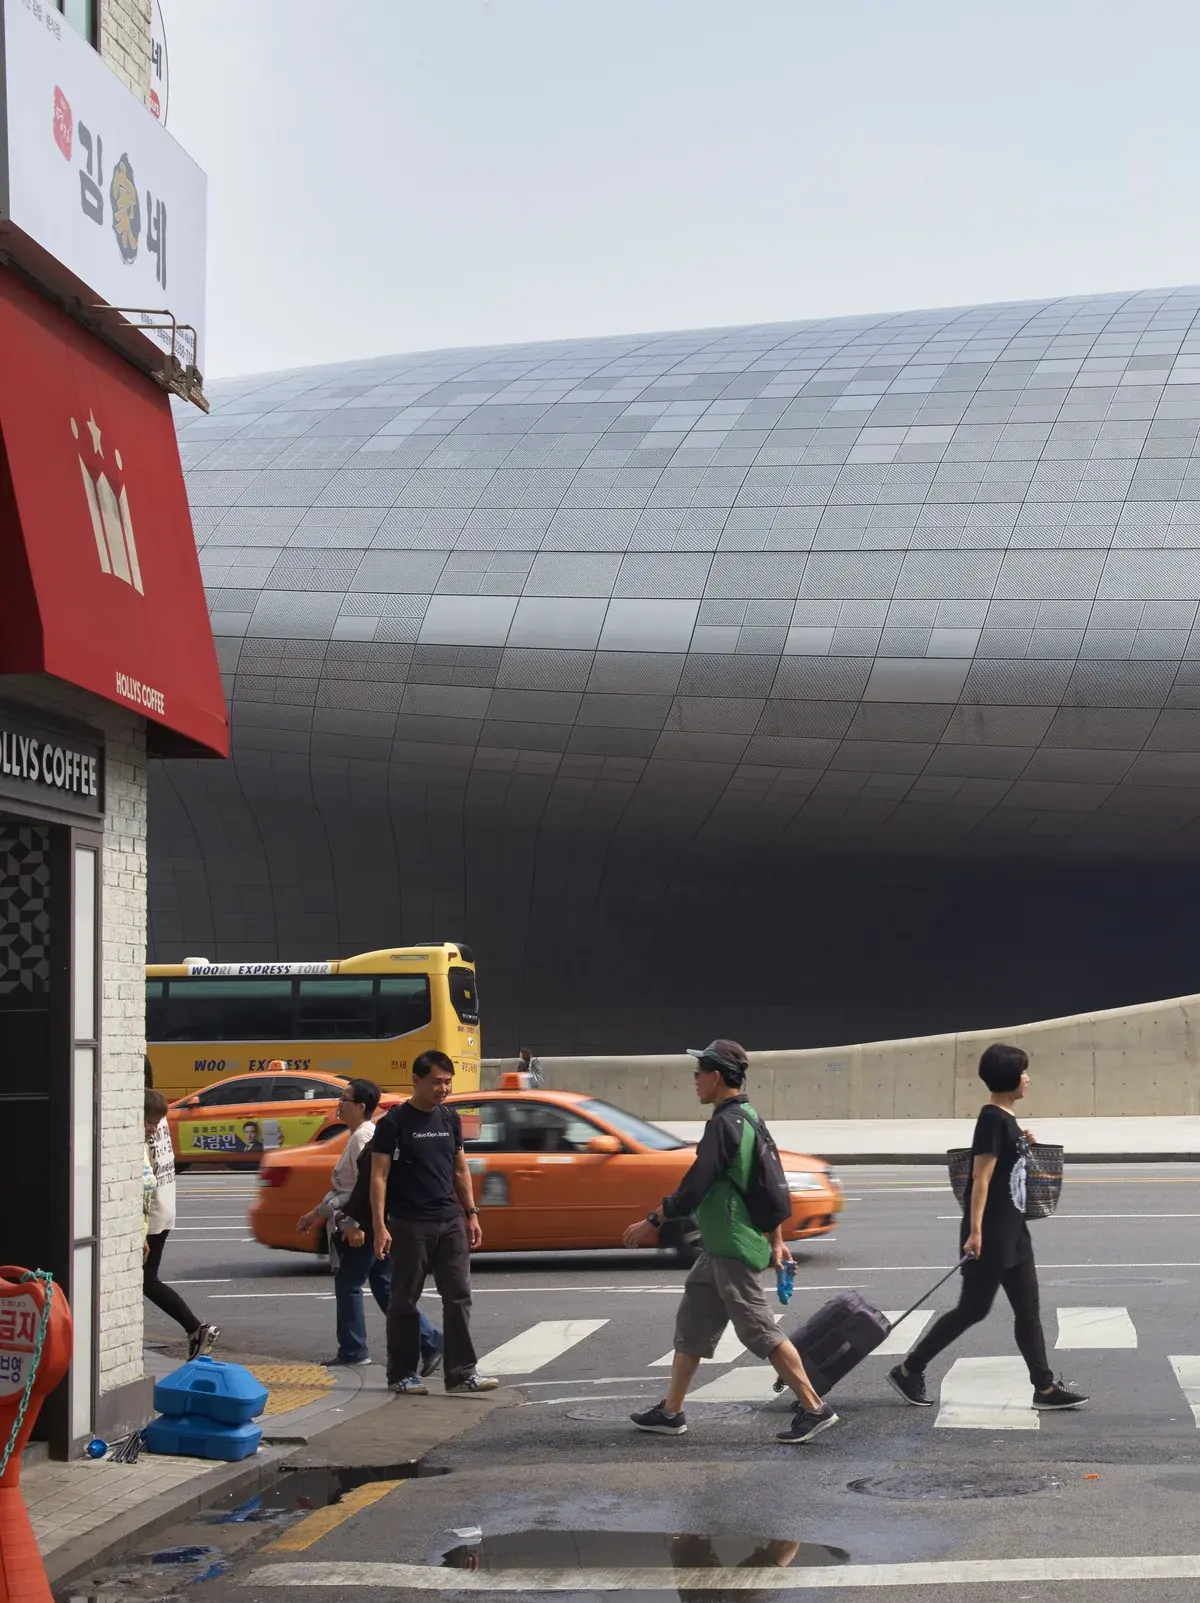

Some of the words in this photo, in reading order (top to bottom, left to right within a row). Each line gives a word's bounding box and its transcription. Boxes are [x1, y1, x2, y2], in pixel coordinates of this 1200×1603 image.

[116, 671, 141, 703] HOLLYS
[141, 684, 165, 715] COFFEE
[0, 730, 39, 781] LLYS
[42, 743, 97, 796] COFFEE
[191, 966, 232, 976] WOORI
[238, 965, 292, 975] EXPRESS
[297, 965, 329, 974] TOUR
[248, 1058, 311, 1071] EXESS
